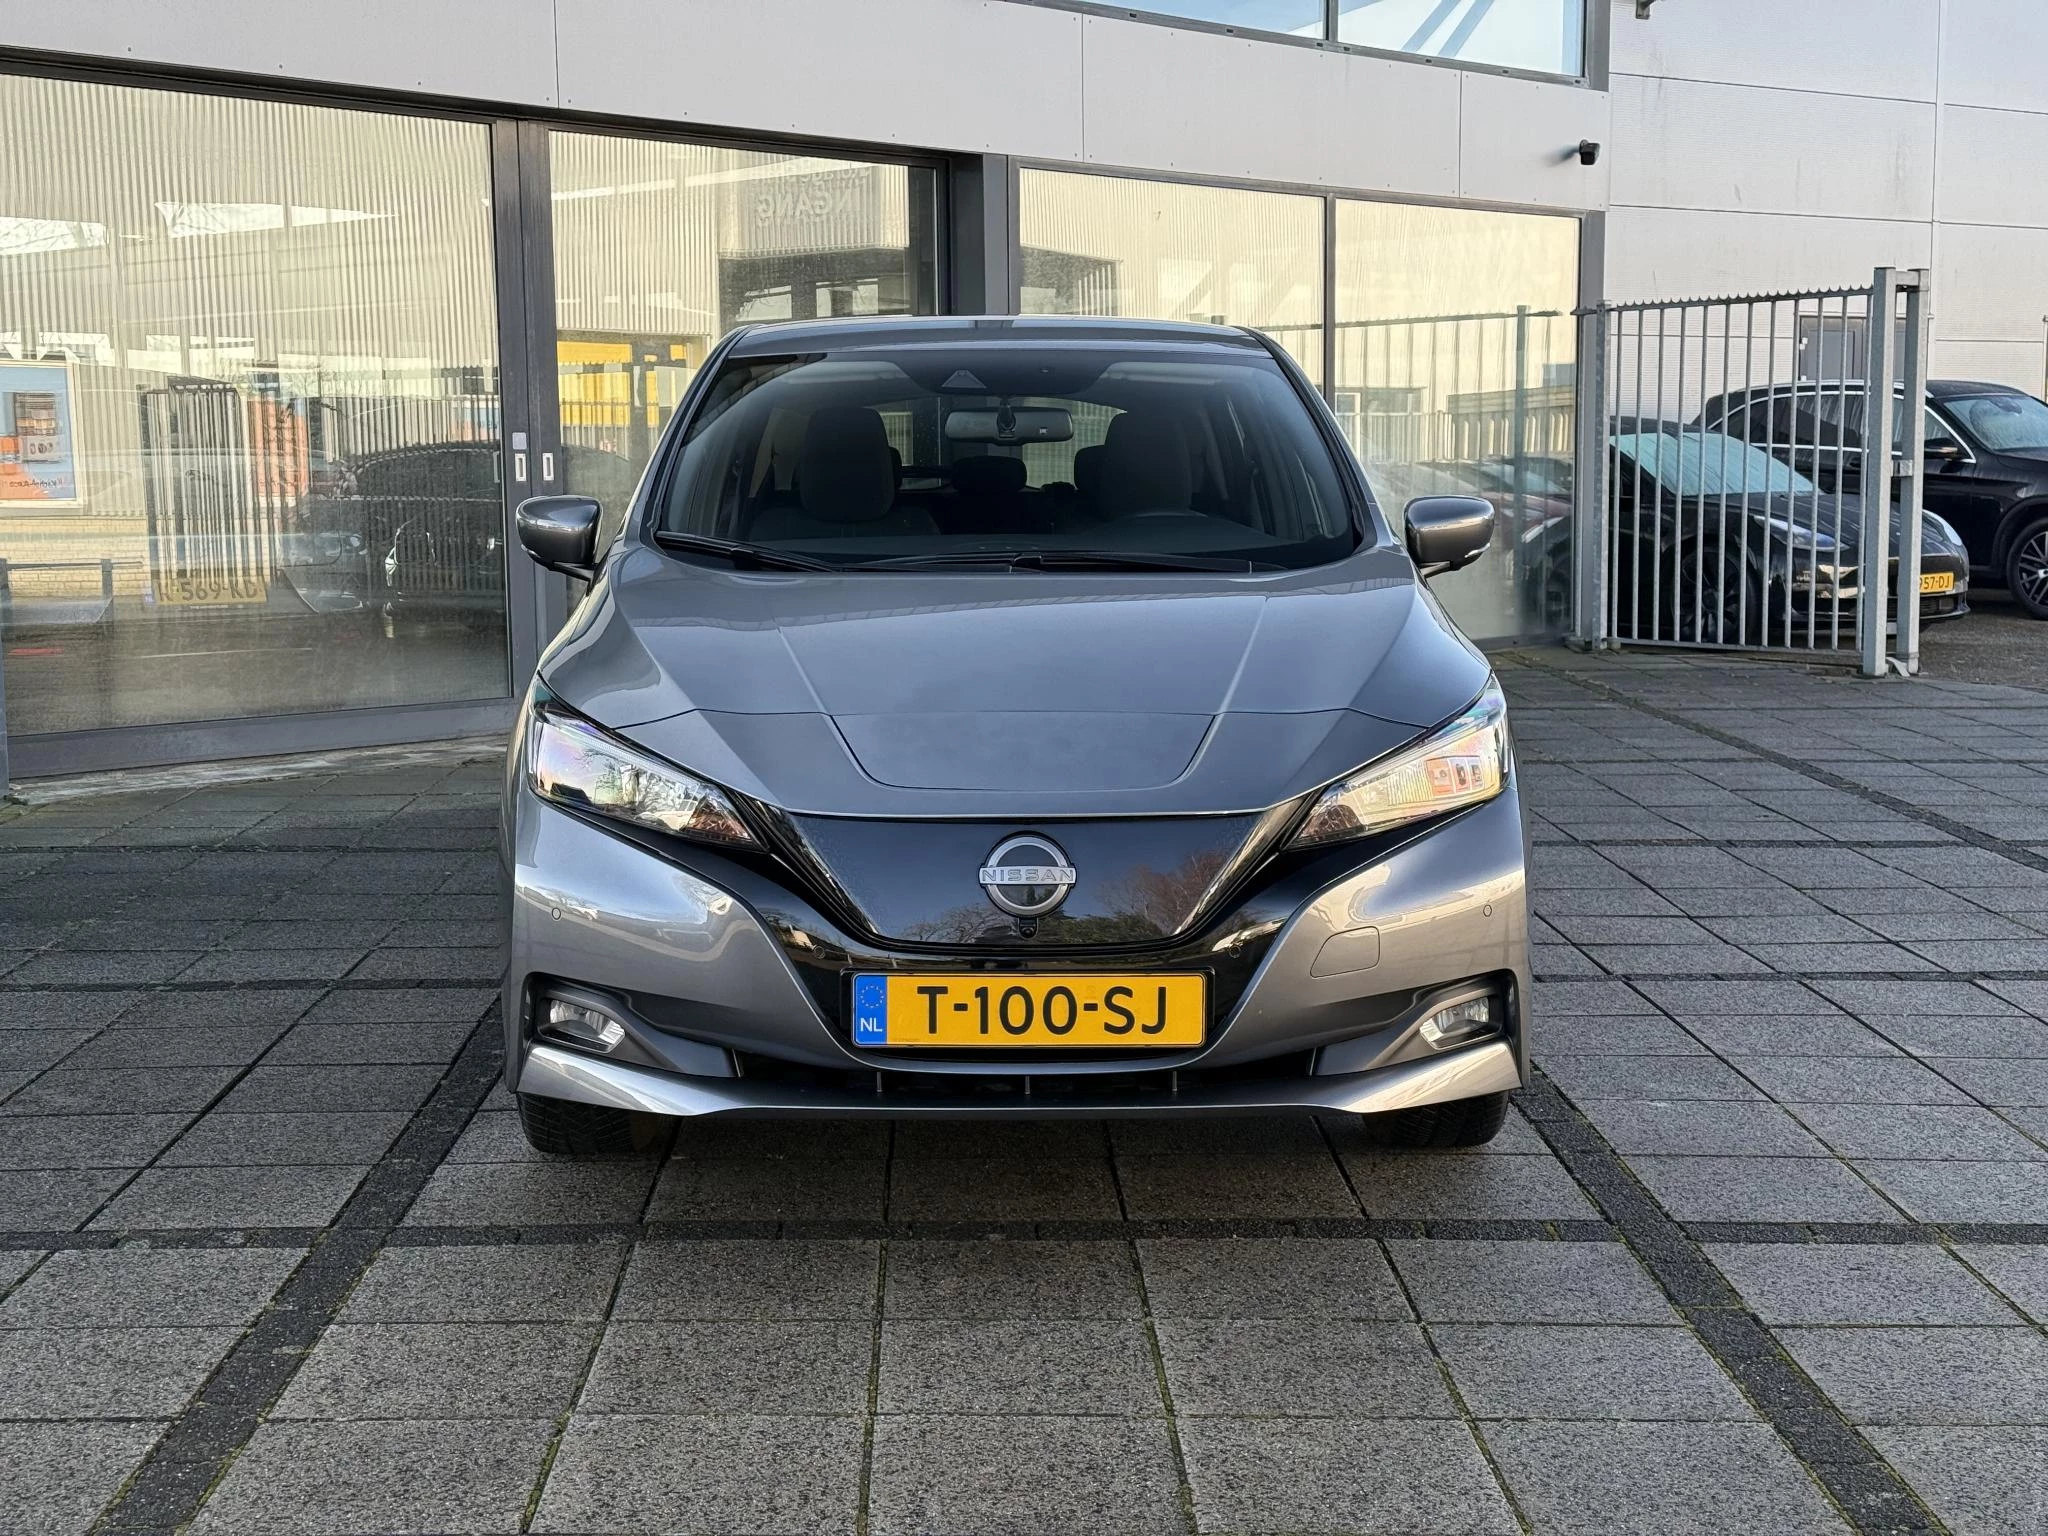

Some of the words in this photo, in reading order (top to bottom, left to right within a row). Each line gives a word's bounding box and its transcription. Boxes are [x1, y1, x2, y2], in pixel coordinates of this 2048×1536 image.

[982, 868, 1073, 881] NISSAN
[917, 986, 1167, 1035] T-100-SJ
[860, 1017, 883, 1032] NL
